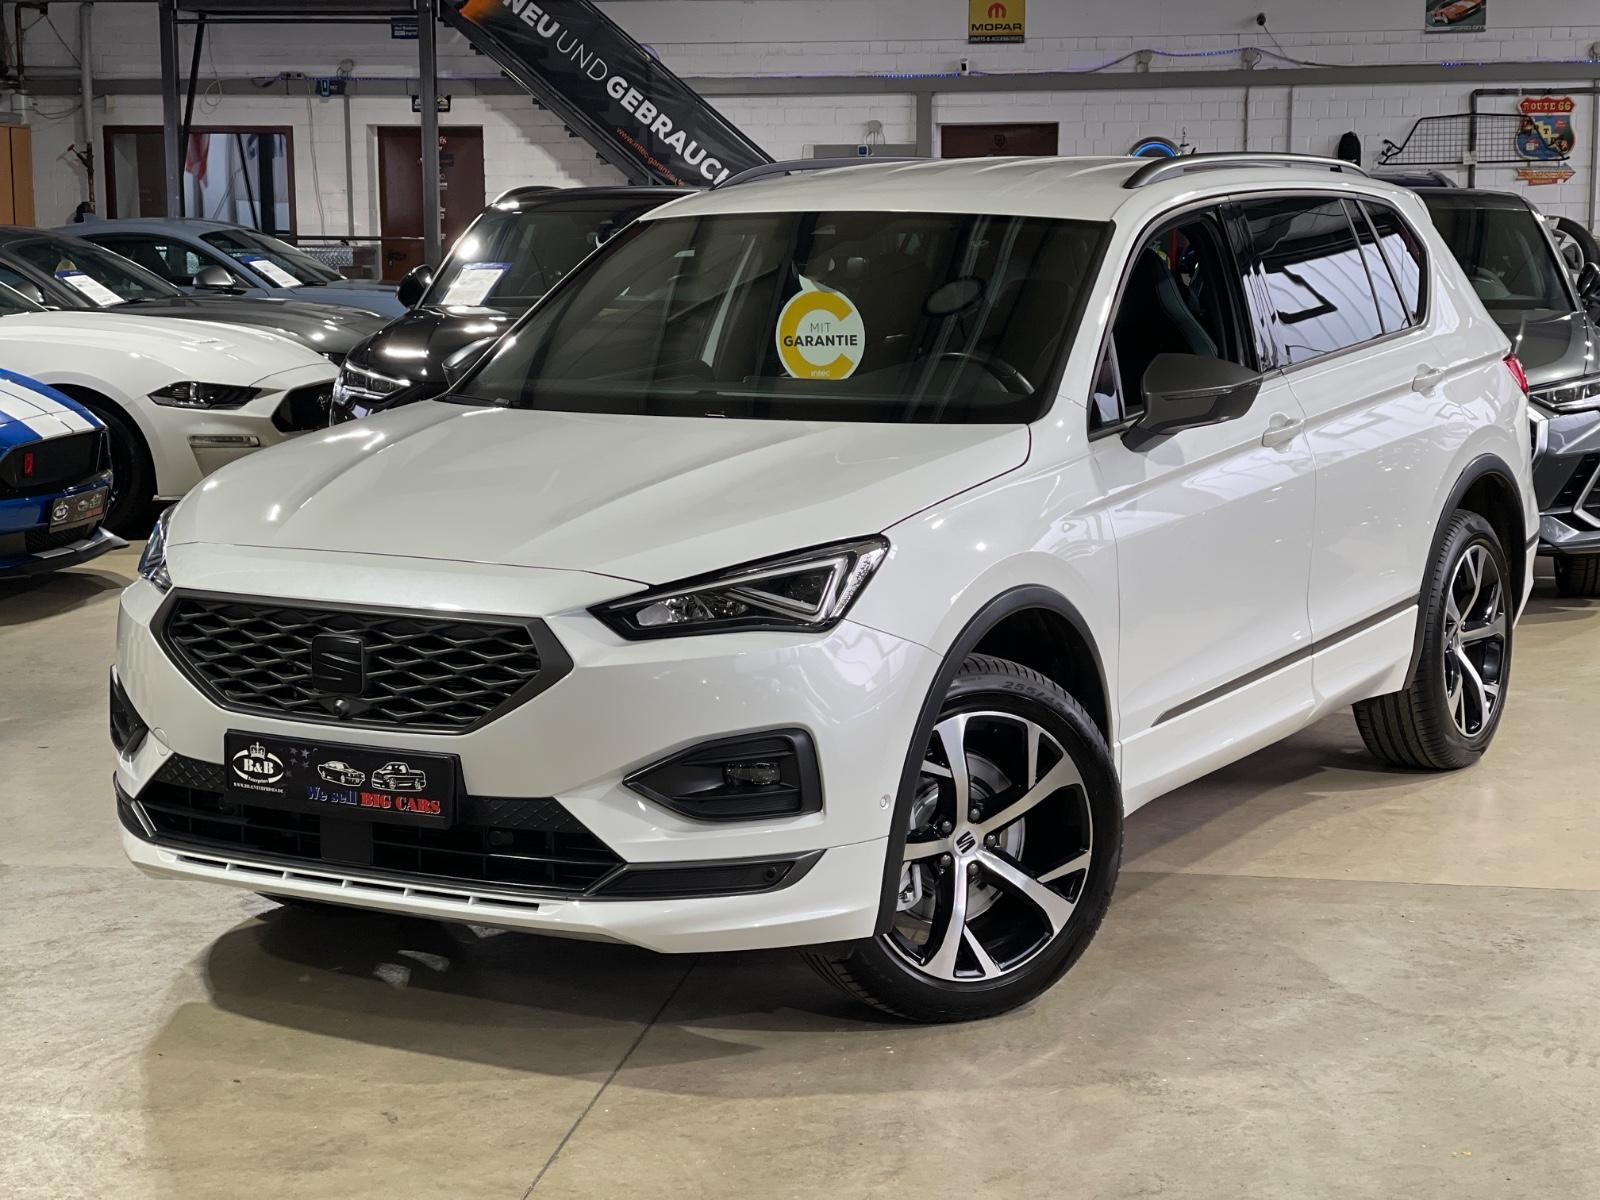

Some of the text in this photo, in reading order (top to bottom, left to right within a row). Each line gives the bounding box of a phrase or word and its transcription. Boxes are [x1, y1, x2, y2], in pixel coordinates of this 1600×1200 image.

[503, 0, 560, 38] NEU
[556, 29, 608, 81] UND
[1523, 102, 1571, 110] ROUTE 66
[810, 322, 832, 333] MIT
[784, 334, 858, 347] GARANTIE
[243, 758, 274, 775] B&B
[307, 786, 441, 815] We sell BIG CARS
